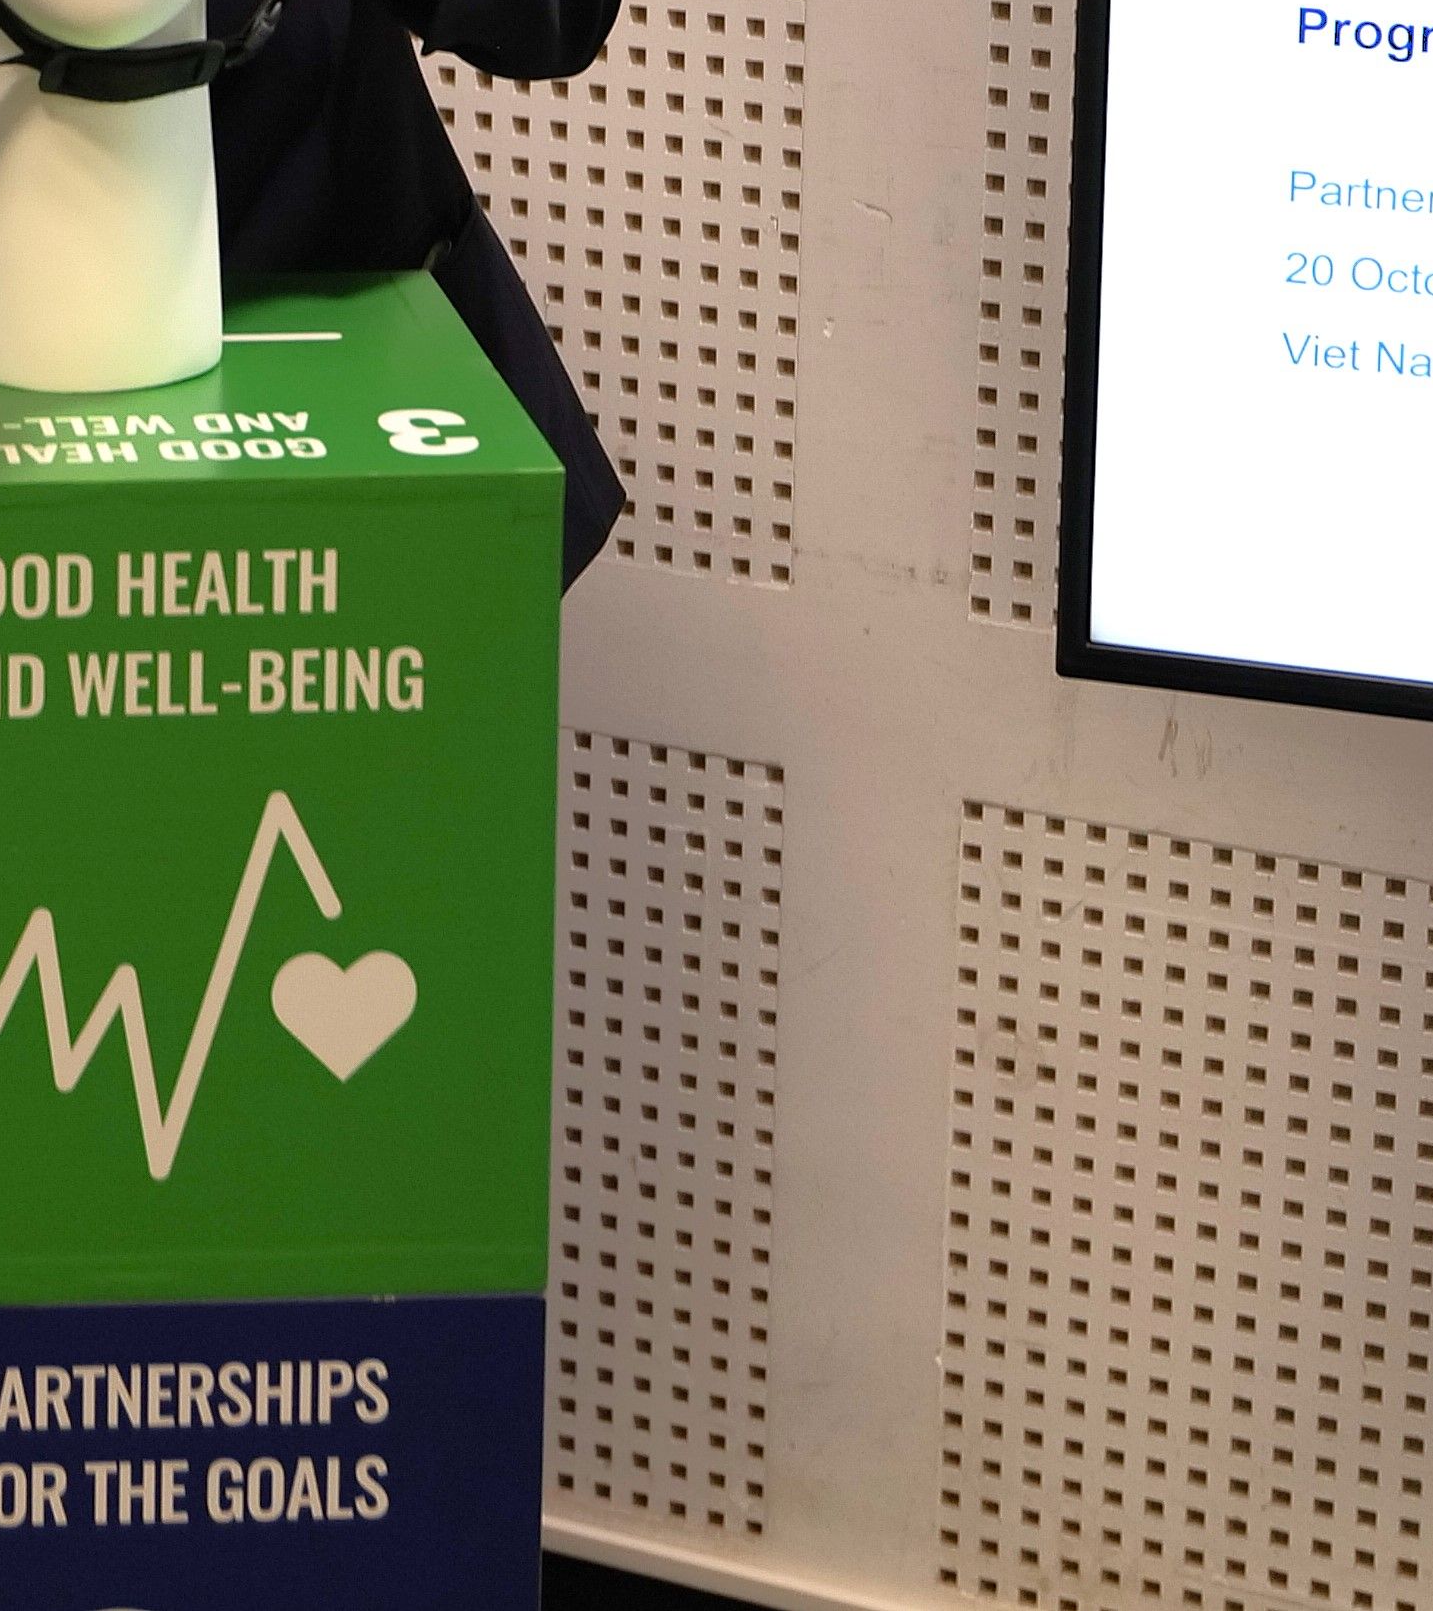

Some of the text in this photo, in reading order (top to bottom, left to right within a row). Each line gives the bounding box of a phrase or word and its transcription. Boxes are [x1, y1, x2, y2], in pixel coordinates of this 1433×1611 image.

[1286, 252, 1333, 286] 20
[1283, 332, 1360, 371] Viet
[193, 412, 308, 433] AND
[378, 409, 479, 455] 3
[158, 438, 326, 461] GOOD
[118, 549, 337, 616] HEALTH
[68, 647, 423, 716] WELL-BEING
[85, 1460, 188, 1524] THE
[207, 1456, 388, 1522] GOALS
